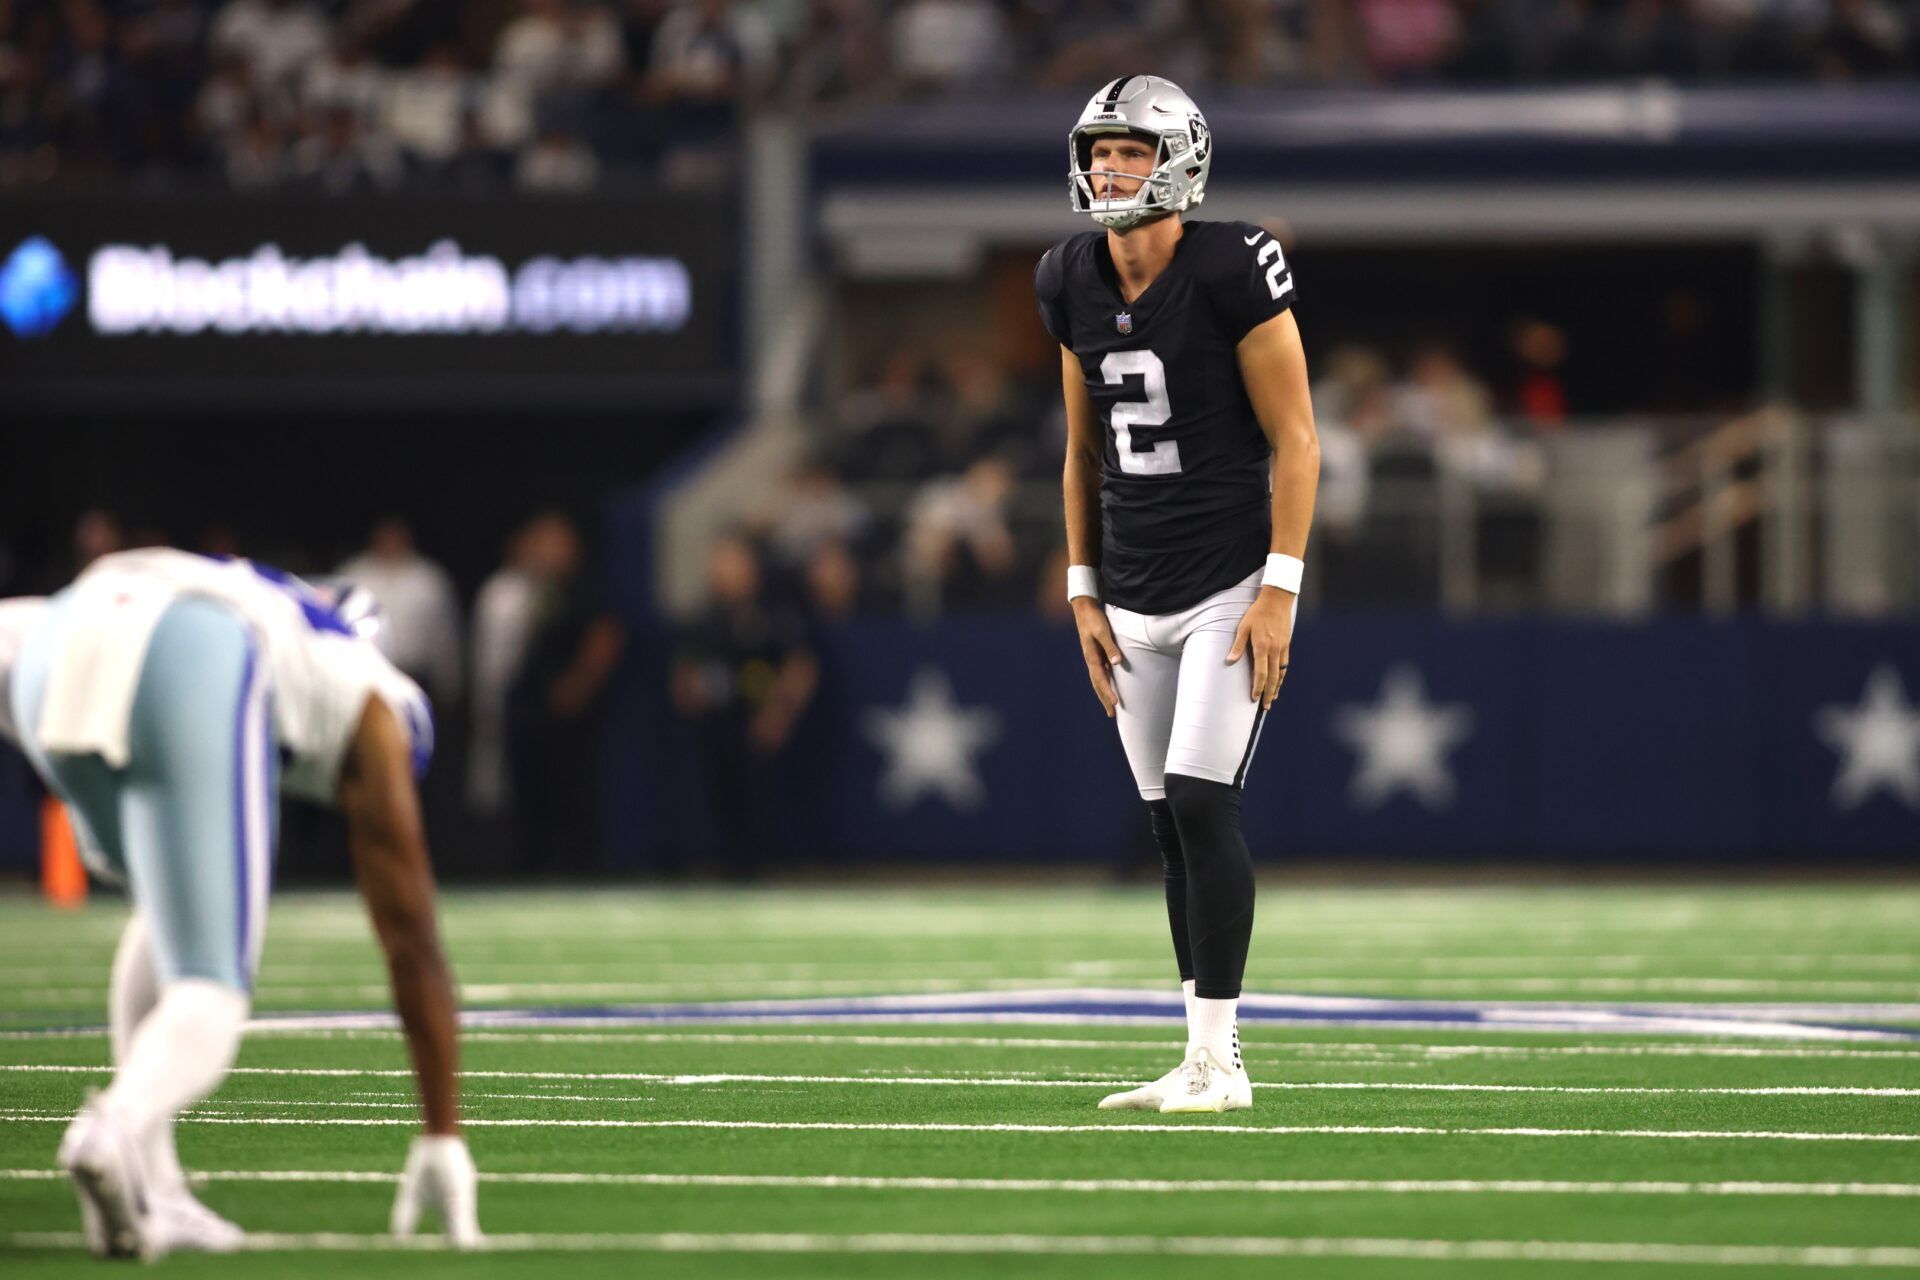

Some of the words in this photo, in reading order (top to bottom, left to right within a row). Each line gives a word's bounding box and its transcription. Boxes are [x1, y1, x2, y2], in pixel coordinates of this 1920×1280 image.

[87, 239, 692, 336] Blockchain.com
[1257, 238, 1294, 301] 2
[1100, 349, 1182, 475] 2
